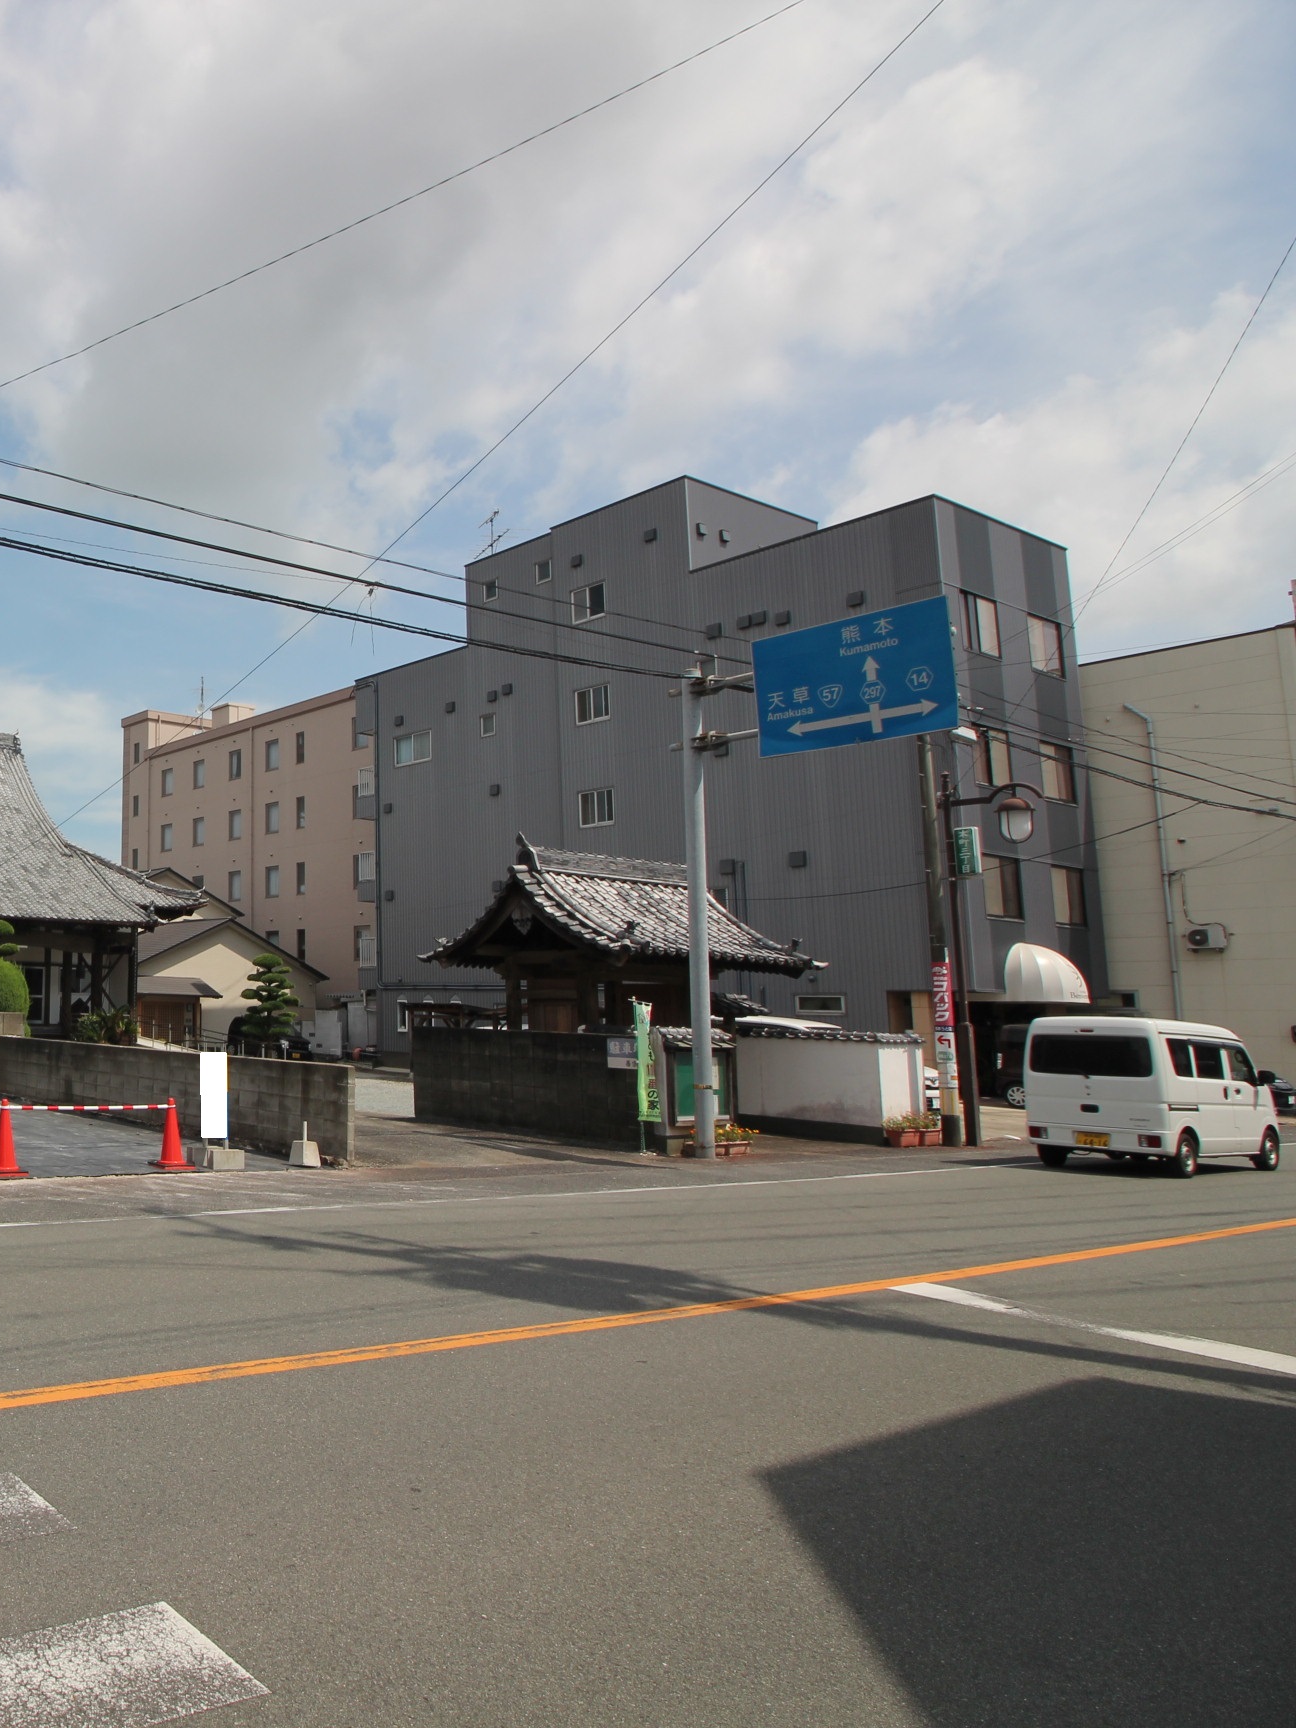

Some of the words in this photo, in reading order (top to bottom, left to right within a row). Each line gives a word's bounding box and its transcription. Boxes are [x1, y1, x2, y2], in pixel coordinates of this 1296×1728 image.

[841, 617, 893, 644] 熊本
[839, 636, 898, 656] Kumamoto
[910, 670, 929, 686] 14
[767, 686, 810, 711] 天草
[822, 687, 842, 701] 57
[863, 685, 881, 700] 297
[767, 706, 813, 721] Amakusa
[609, 1041, 638, 1056] 駐車
